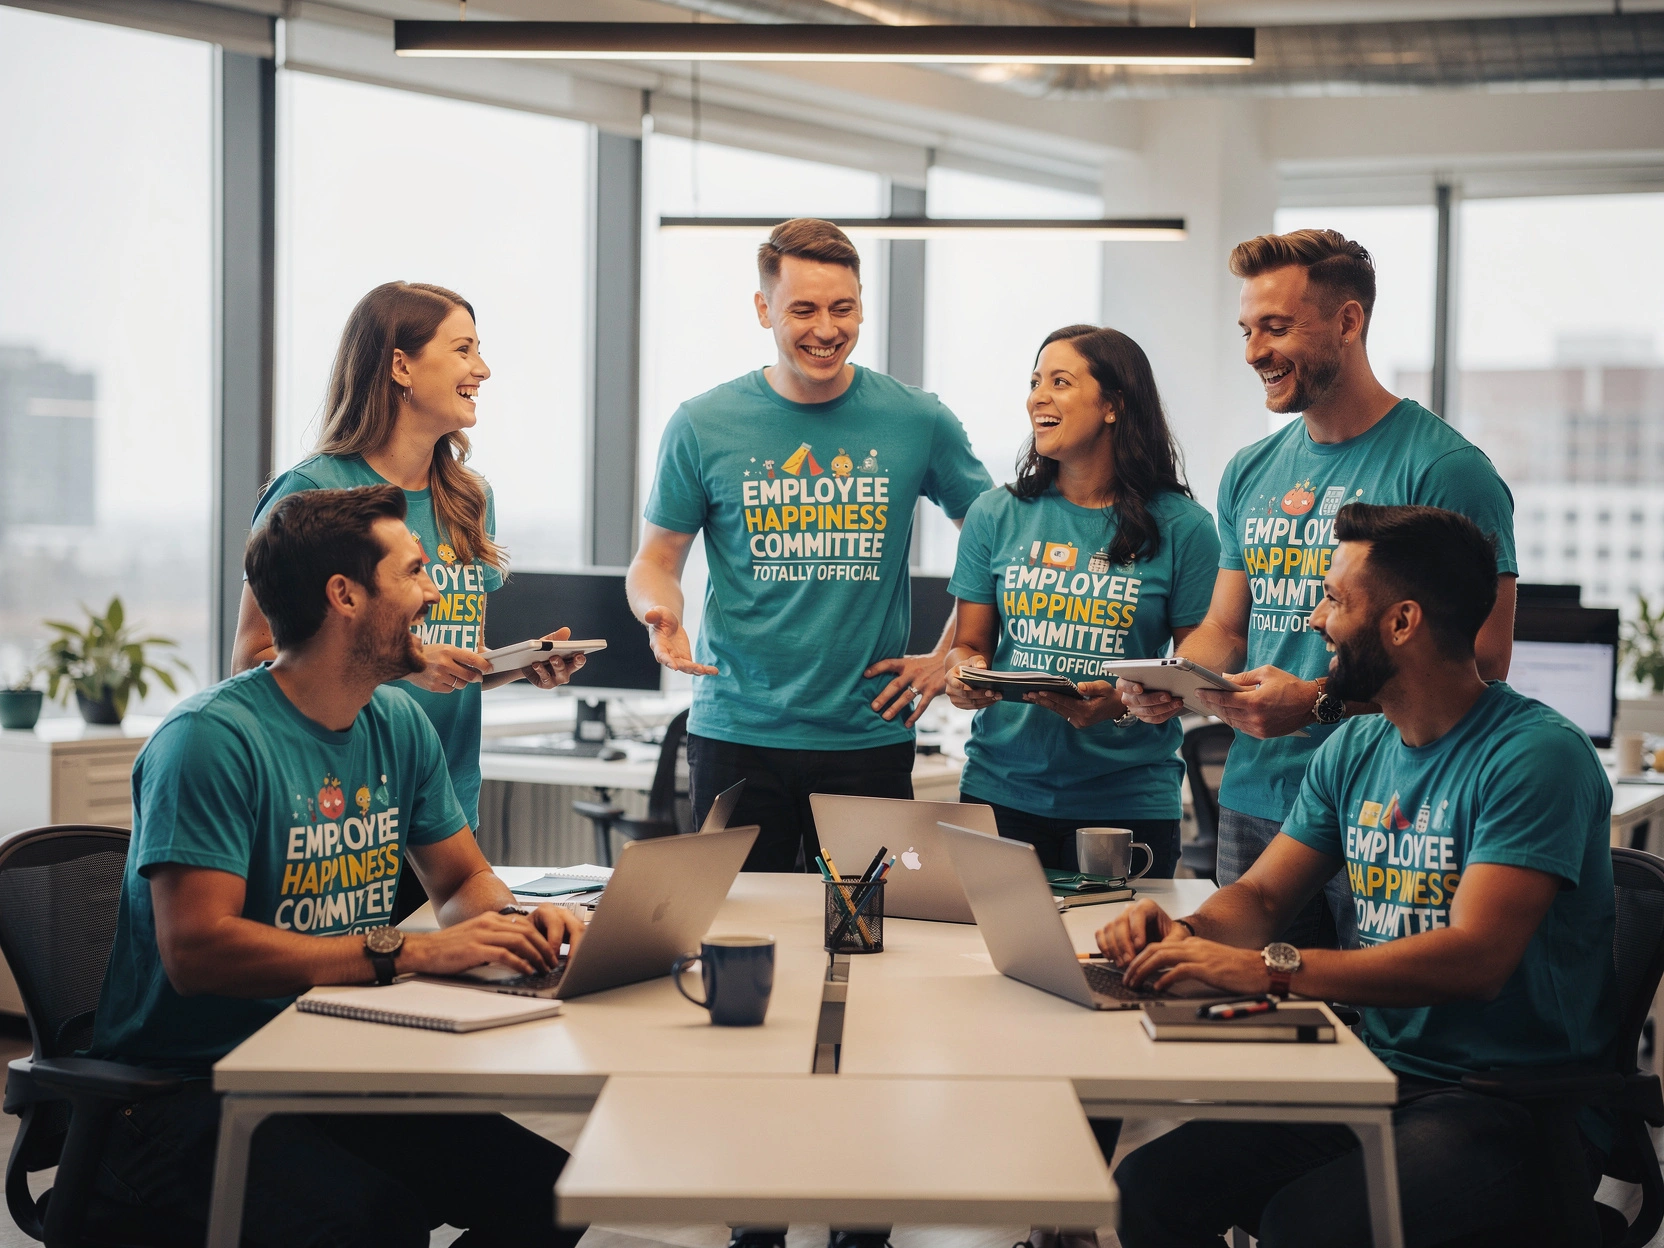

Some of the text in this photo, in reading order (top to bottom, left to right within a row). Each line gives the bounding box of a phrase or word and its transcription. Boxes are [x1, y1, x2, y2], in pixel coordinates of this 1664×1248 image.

[742, 477, 890, 506] EMPLOYEE
[745, 504, 889, 533] HAPPINESS
[750, 532, 886, 558] COMMITTEE
[752, 564, 881, 582] TOTALLY OFFICIAL
[1004, 565, 1142, 604] EMPLOYEE
[1003, 591, 1137, 628] HAPPINESS
[1007, 618, 1129, 654] COMMITTEE
[1346, 826, 1458, 870] EMPLOYEE
[280, 843, 399, 896] HAPPINESS
